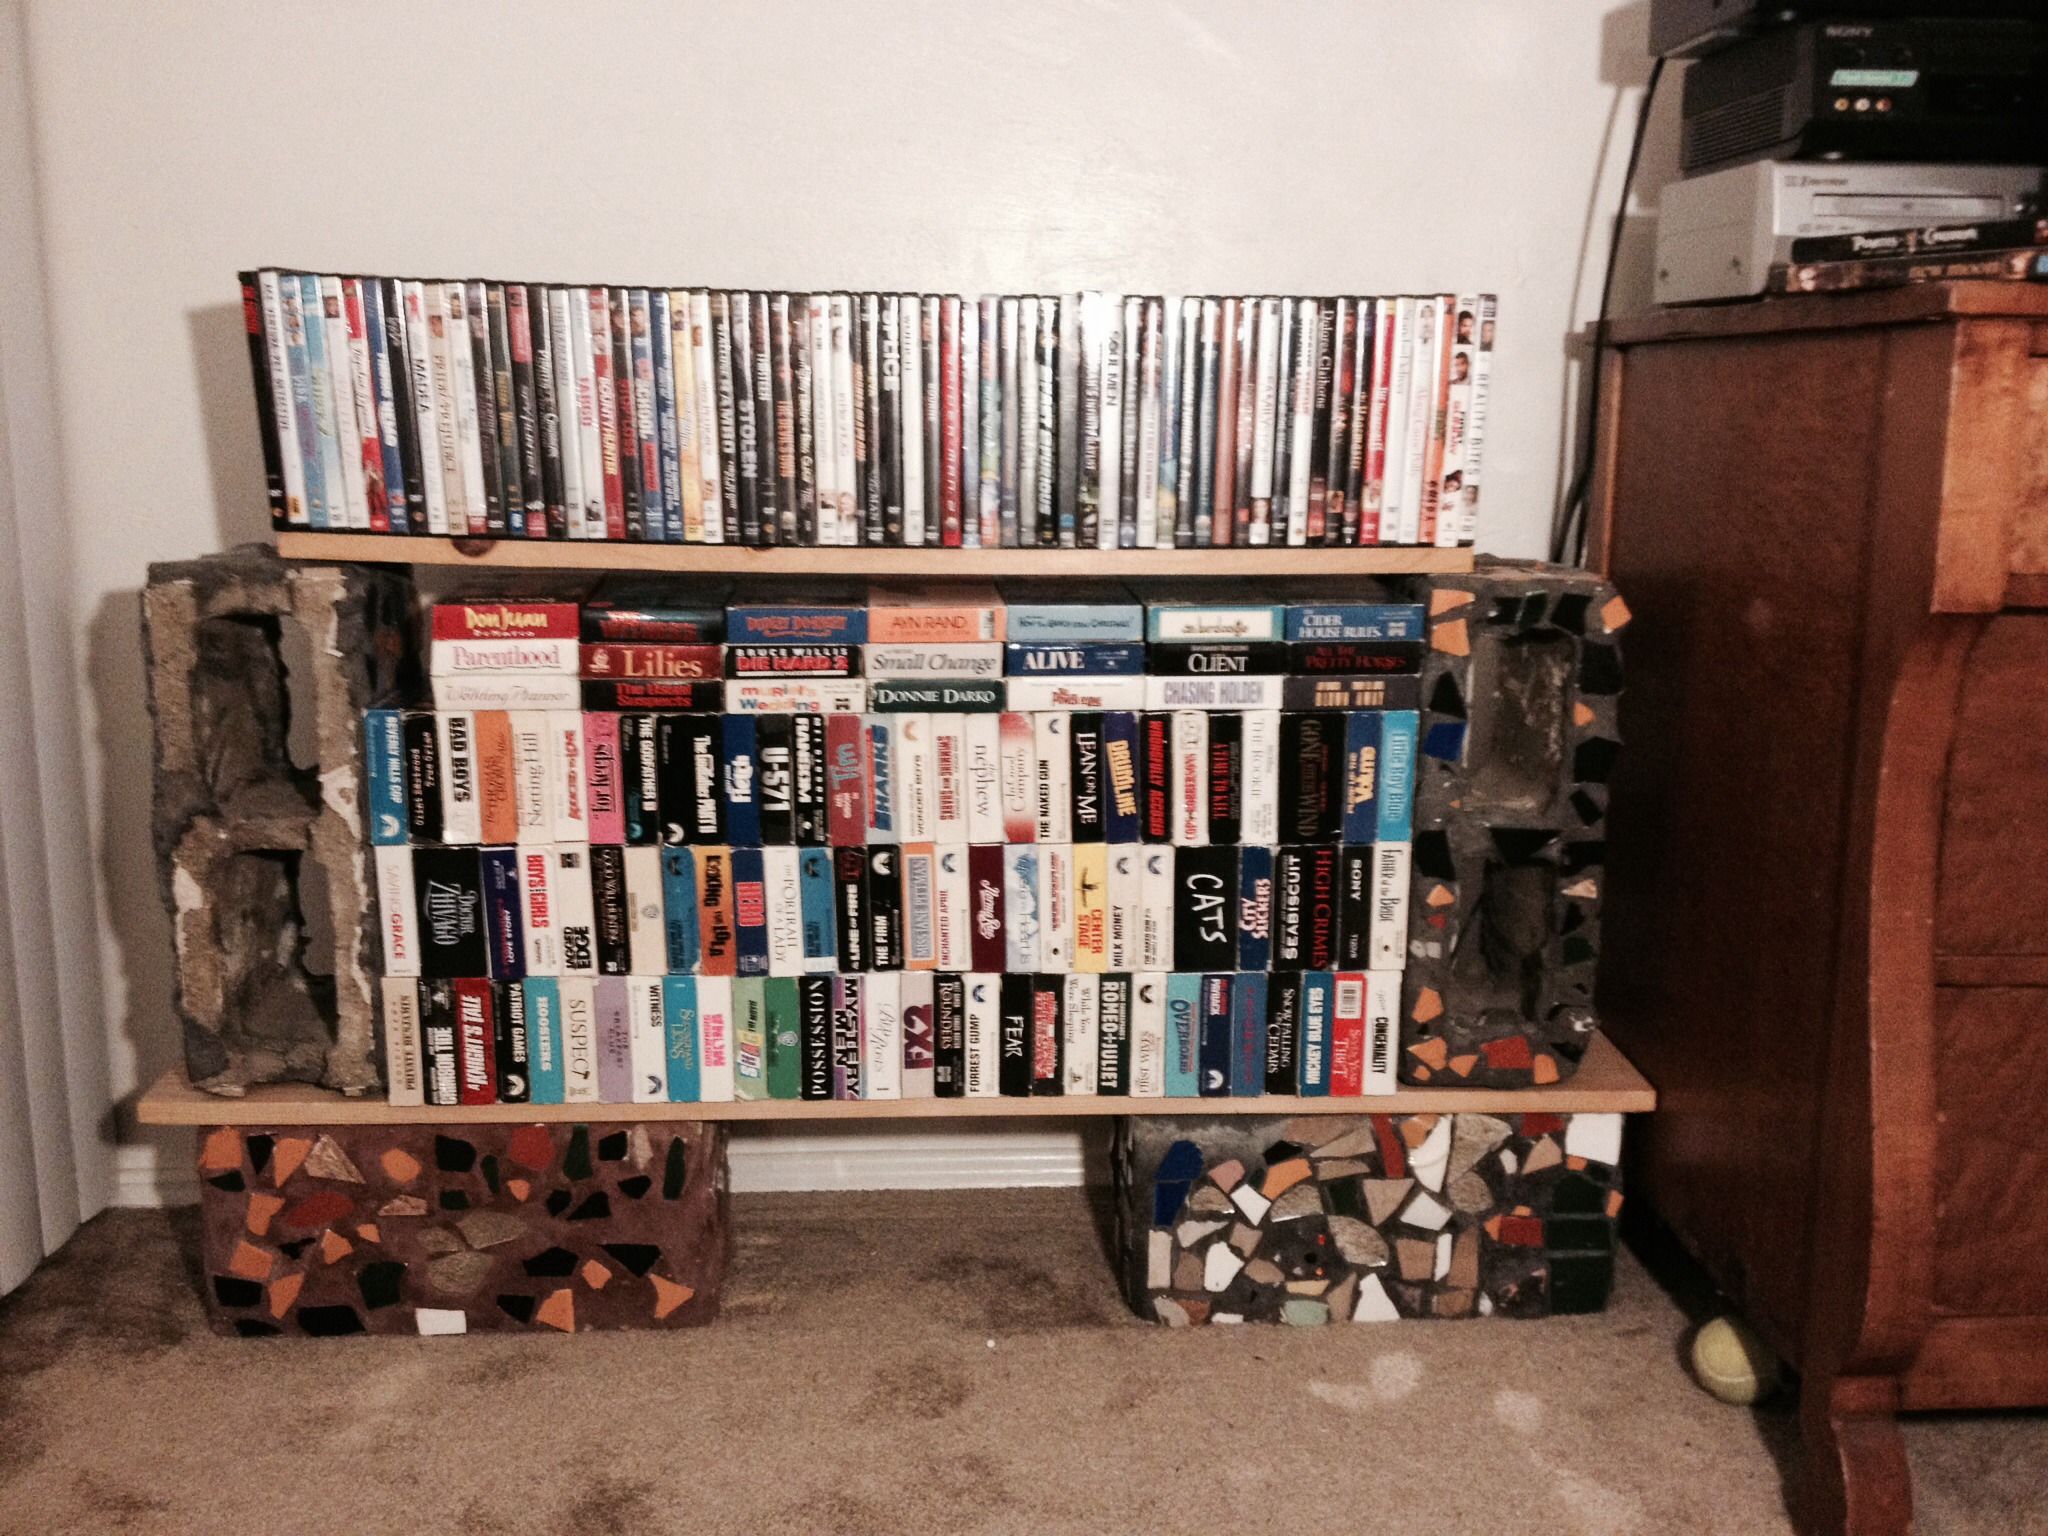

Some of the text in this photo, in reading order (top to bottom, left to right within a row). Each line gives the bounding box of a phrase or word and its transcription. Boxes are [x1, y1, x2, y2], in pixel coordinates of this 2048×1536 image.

[884, 311, 900, 392] SPLICE
[1106, 331, 1119, 408] SOUL MEN
[1315, 310, 1336, 409] Dolores Claiborne
[720, 381, 736, 454] RAMBO
[739, 399, 757, 479] STOLEN
[1466, 373, 1490, 477] REALITY BITES
[735, 647, 849, 657] BRUCE WILLIS
[891, 615, 969, 630] AYN RAND
[1298, 626, 1341, 638] HOUSE
[1302, 615, 1343, 626] CIDER
[453, 645, 561, 667] Parenthood
[621, 649, 704, 677] Lilies
[736, 655, 849, 671] DIE HARD 2
[872, 653, 998, 675] Small Change
[1022, 651, 1086, 670] ALIVE
[1187, 653, 1249, 673] CLIENT
[1164, 681, 1264, 705] CHASING HOLDEN
[385, 716, 403, 804] BEVERLY HILLS COP
[449, 717, 471, 802] BAD BOYS
[521, 731, 546, 827] Notting Hill
[639, 717, 656, 799] THE GODFATHER
[693, 735, 717, 834] The PART II
[761, 747, 791, 811] U-571
[936, 735, 956, 821] SWIMMING SHARKS
[969, 745, 996, 817] nephew
[1076, 732, 1098, 776] LEAN
[1085, 776, 1097, 794] ON
[1106, 740, 1137, 817] DRUMLINE
[1149, 720, 1165, 836] WRONGFULLY ACCUSED
[1213, 751, 1229, 820] TIME TO KILL
[1297, 720, 1321, 837] GONE WIND
[1386, 733, 1409, 822] Little Boy Blue
[914, 754, 924, 835] WONDER BOYS
[1039, 760, 1051, 838] THE NAKED GUN
[1077, 795, 1098, 825] ME
[429, 881, 461, 946] ZHIVAGO
[459, 890, 479, 937] DOCTOR
[526, 855, 549, 929] BOYS GIRLS
[603, 849, 619, 946] GOOD WILL HUNTING
[976, 880, 1001, 940] Norma Rae
[1186, 874, 1228, 943] CATS
[1239, 898, 1257, 931] CITY
[1251, 879, 1272, 940] SLICKERS
[1284, 855, 1301, 960] SEABISCUIT
[1311, 850, 1333, 969] HIGH CRIMES
[1350, 859, 1362, 901] SONY
[1379, 849, 1404, 922] FATHER BRIDE
[391, 914, 406, 960] GRACE
[504, 910, 513, 939] STORY
[507, 941, 515, 964] LOVE
[563, 926, 576, 970] JAGGED
[575, 926, 593, 970] EDGE
[774, 879, 799, 963] PORTRAIT LADY
[846, 884, 860, 961] LINE FIRE
[874, 916, 889, 967] THE FIRM
[939, 890, 950, 966] ENCHANTED APRIL
[1077, 914, 1091, 949] STAGE
[1090, 909, 1104, 954] CENTER
[1112, 905, 1124, 967] MILK MONEY
[460, 994, 484, 1024] TALE
[510, 983, 526, 1063] PATRIOT GAMES
[649, 985, 663, 1028] WITNESS
[938, 982, 954, 1050] ROUNDERS
[1066, 979, 1079, 1044] Were Sleeping
[1080, 988, 1092, 1035] While You
[1209, 979, 1221, 1016] PAYBACK
[1280, 988, 1296, 1068] SNOW FALLING
[400, 995, 417, 1091] PRIVATE BENJAMIN
[434, 1027, 458, 1105] CRIMSON TIDE
[462, 1024, 489, 1085] KNIGHT'S
[536, 996, 552, 1072] HOOSIERS
[569, 1000, 590, 1080] SUSPECT
[808, 979, 828, 1096] POSSESSION
[834, 1009, 847, 1067] MEN
[845, 978, 860, 1096] MYSTERY
[904, 1003, 934, 1070] FX2
[969, 1014, 980, 1093] FORREST GUMP
[1004, 1015, 1025, 1058] FEAR
[1100, 981, 1120, 1089] ROMEO+JULIET
[1170, 1000, 1192, 1075] OVERBOARD
[1267, 1023, 1281, 1074] CEDARS
[1305, 987, 1324, 1085] MICKEY BLUE EYES
[1372, 1016, 1391, 1074] CONGENIALITY
